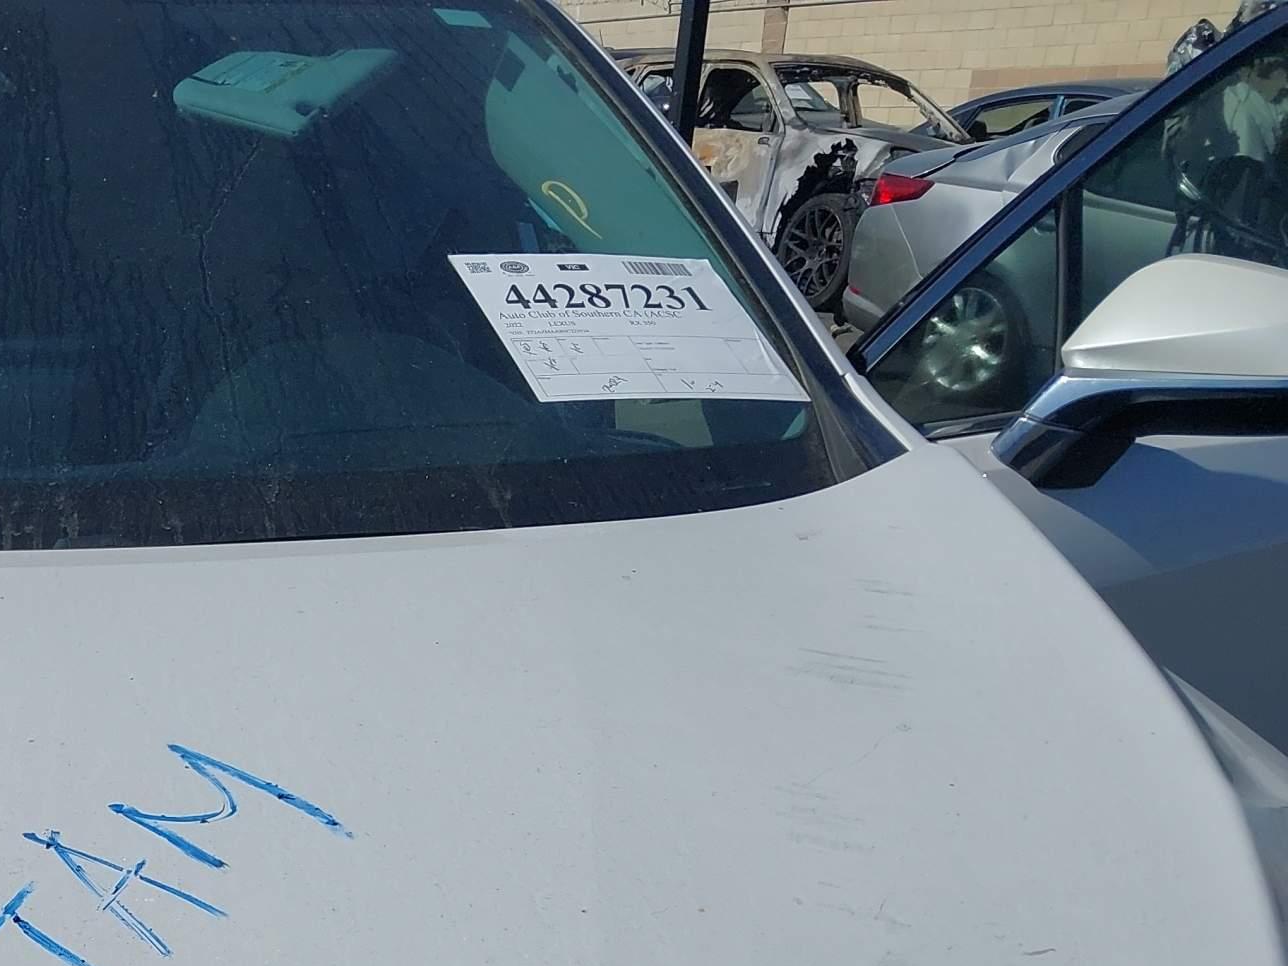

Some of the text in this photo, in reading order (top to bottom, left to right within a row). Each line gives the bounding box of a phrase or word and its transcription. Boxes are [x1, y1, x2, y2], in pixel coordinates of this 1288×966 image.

[505, 283, 712, 311] 44287231
[499, 311, 526, 320] Auto
[528, 310, 556, 319] Club
[558, 310, 570, 318] of
[573, 309, 621, 318] Southern
[623, 310, 642, 318] CA
